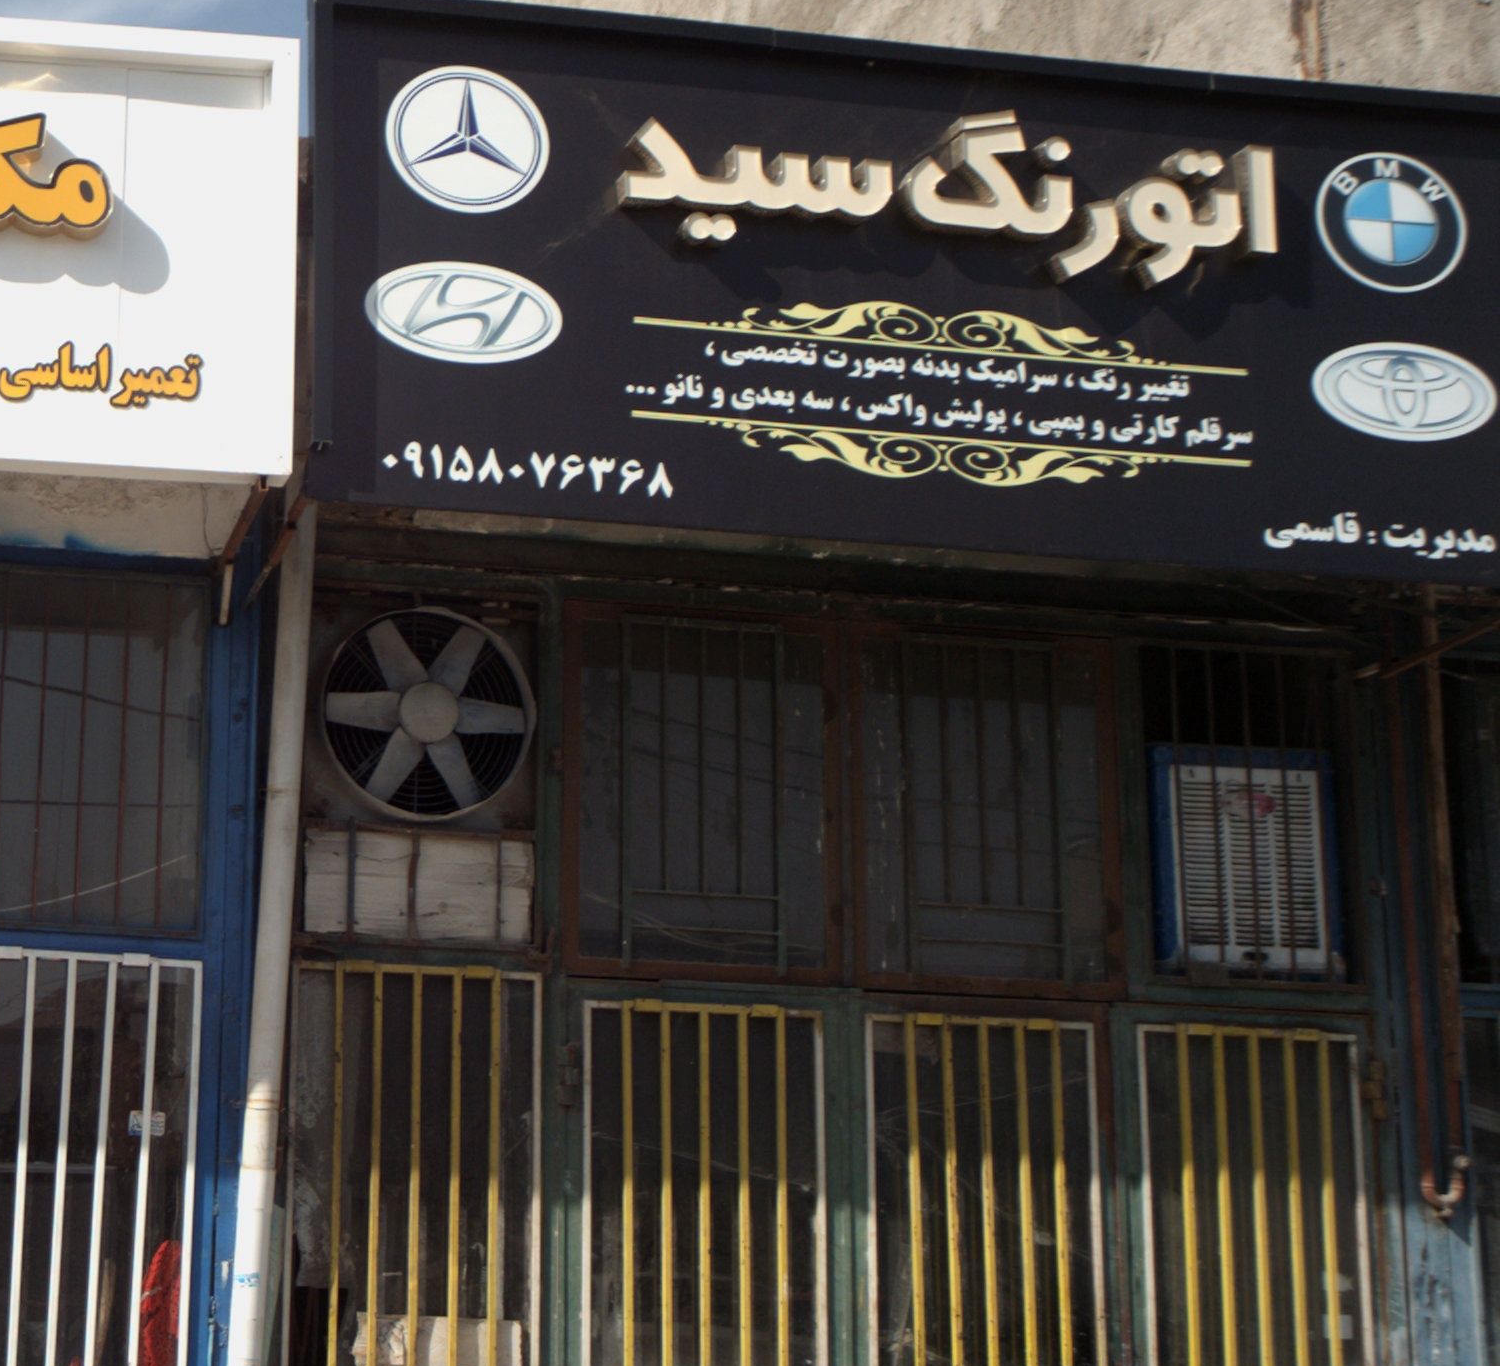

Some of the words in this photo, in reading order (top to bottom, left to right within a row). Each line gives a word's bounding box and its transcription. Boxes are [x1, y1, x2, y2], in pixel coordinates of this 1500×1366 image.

[617, 117, 893, 246] سید
[1332, 159, 1447, 203] BMW
[720, 341, 818, 367] تخصصی
[822, 348, 906, 379] بصورت
[912, 352, 960, 384] بدنه
[110, 354, 203, 408] تعمیر
[661, 373, 704, 404] نانو
[966, 359, 1058, 392] سرامیک
[1079, 368, 1132, 400] رنگ
[1137, 374, 1190, 402] تغییر
[710, 387, 725, 408] و
[730, 386, 796, 413] بعدی
[801, 389, 834, 410] سه
[856, 393, 928, 426] واکس
[932, 397, 1008, 433] پولیش
[1028, 411, 1085, 439] پمپی
[1091, 418, 1104, 440] و
[1109, 414, 1180, 445] کارتی
[382, 440, 674, 498] ۰۹۱۵۸۰۷۶۳۶۸
[1263, 512, 1361, 549] قاسمی
[1382, 523, 1497, 559] مدیریت
